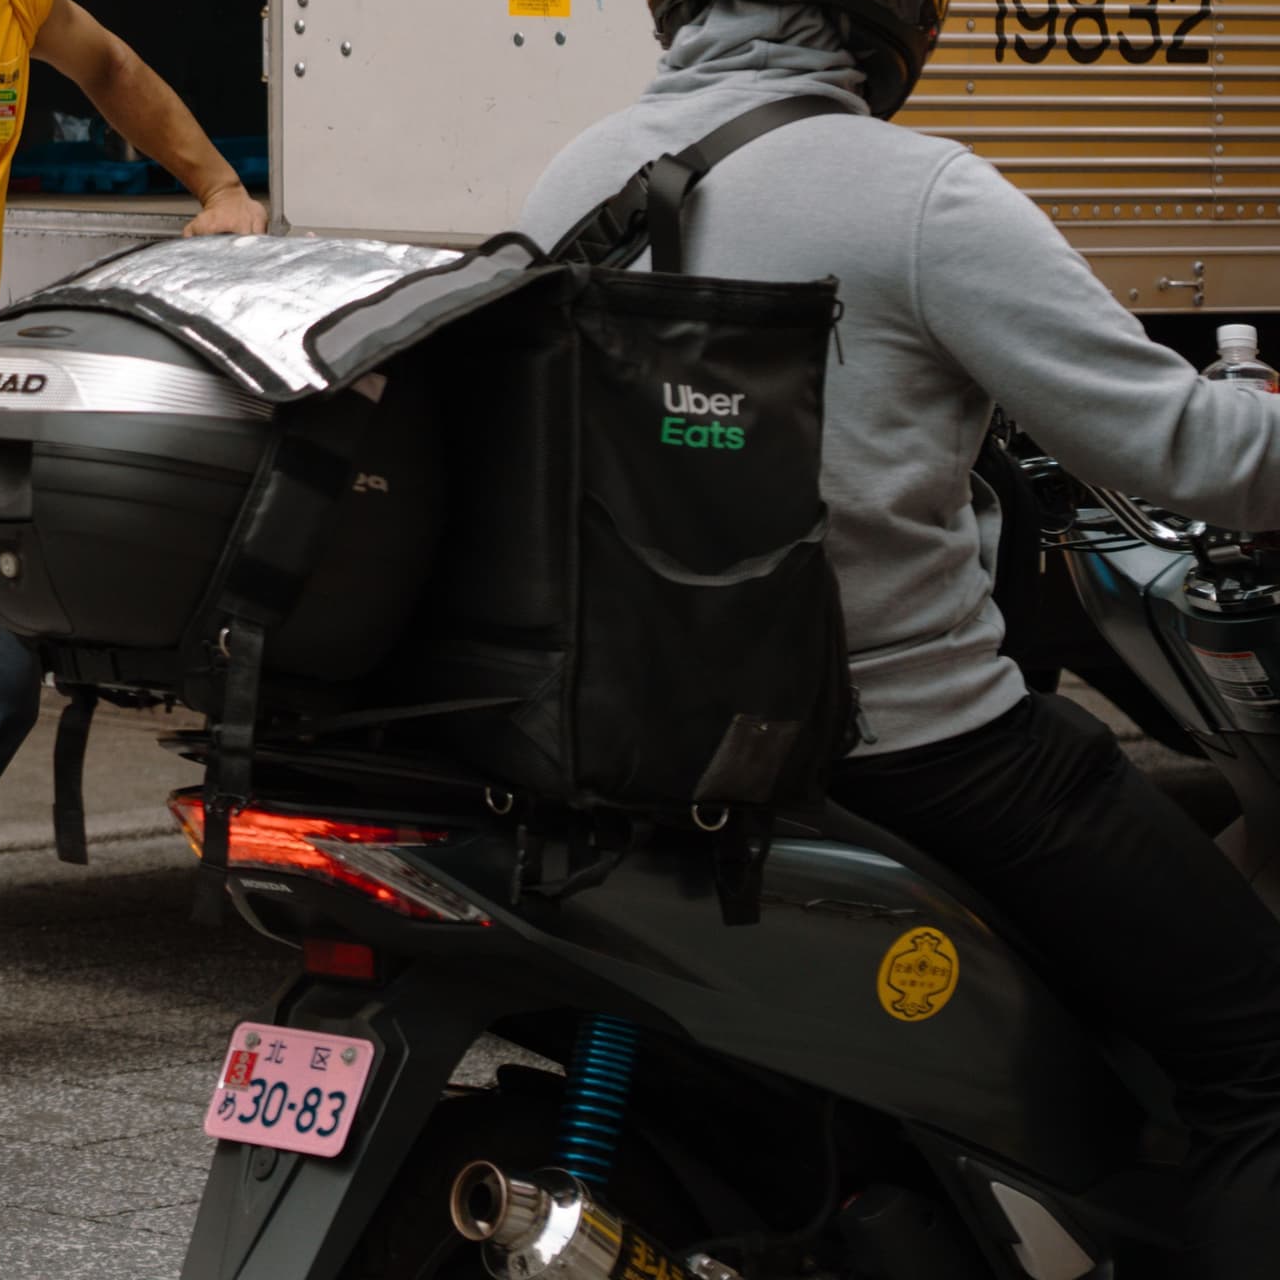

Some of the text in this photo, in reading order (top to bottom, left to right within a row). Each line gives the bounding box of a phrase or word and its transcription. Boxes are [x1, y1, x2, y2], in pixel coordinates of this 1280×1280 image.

[662, 381, 746, 416] Uber
[659, 415, 746, 451] Eats
[263, 1039, 333, 1072] 北区
